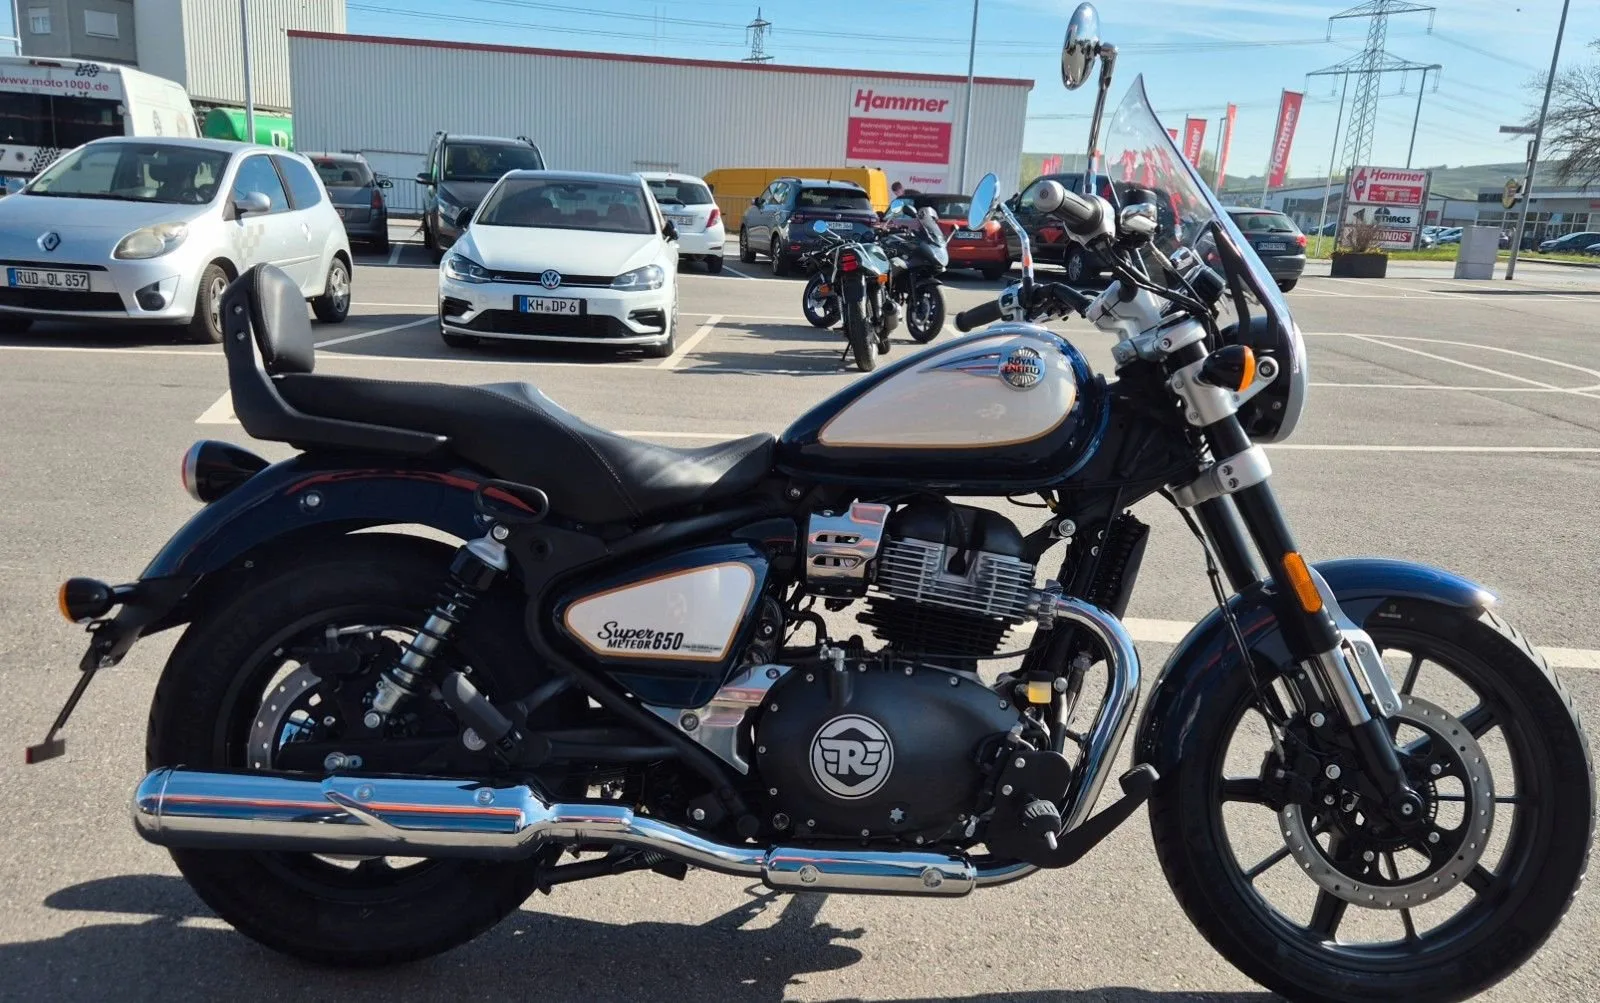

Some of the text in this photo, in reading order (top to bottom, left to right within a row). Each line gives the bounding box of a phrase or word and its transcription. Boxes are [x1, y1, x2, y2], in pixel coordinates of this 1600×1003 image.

[855, 89, 949, 112] Hammer
[1370, 168, 1425, 181] Hammer
[46, 273, 63, 286] QL
[65, 274, 87, 287] 857
[528, 299, 577, 313] KH DP 6
[1007, 356, 1037, 366] ROYAL
[1004, 365, 1041, 375] ENFIELD
[597, 621, 655, 642] Super
[607, 632, 685, 650] METEOR 650
